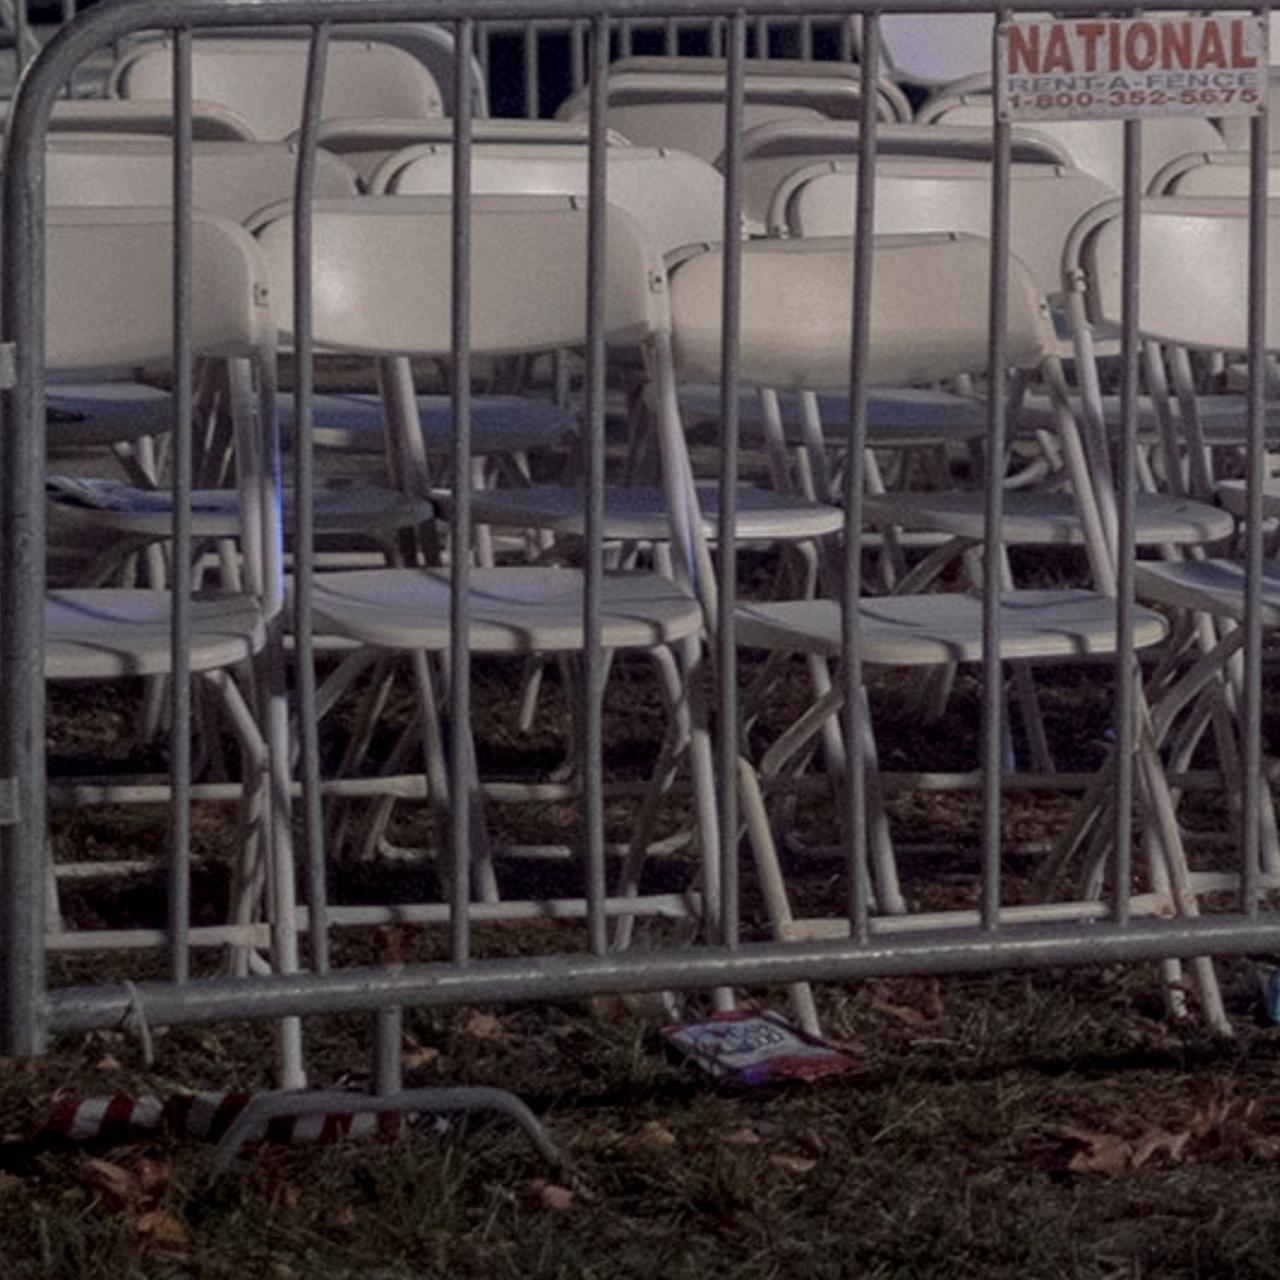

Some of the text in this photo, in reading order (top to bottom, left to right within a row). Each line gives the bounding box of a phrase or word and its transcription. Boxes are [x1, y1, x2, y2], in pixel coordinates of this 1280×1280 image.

[1007, 20, 1257, 74] NATIONAL
[1008, 73, 1258, 92] RENT-A-FENCE
[1008, 89, 1258, 109] 1-800-352-5675
